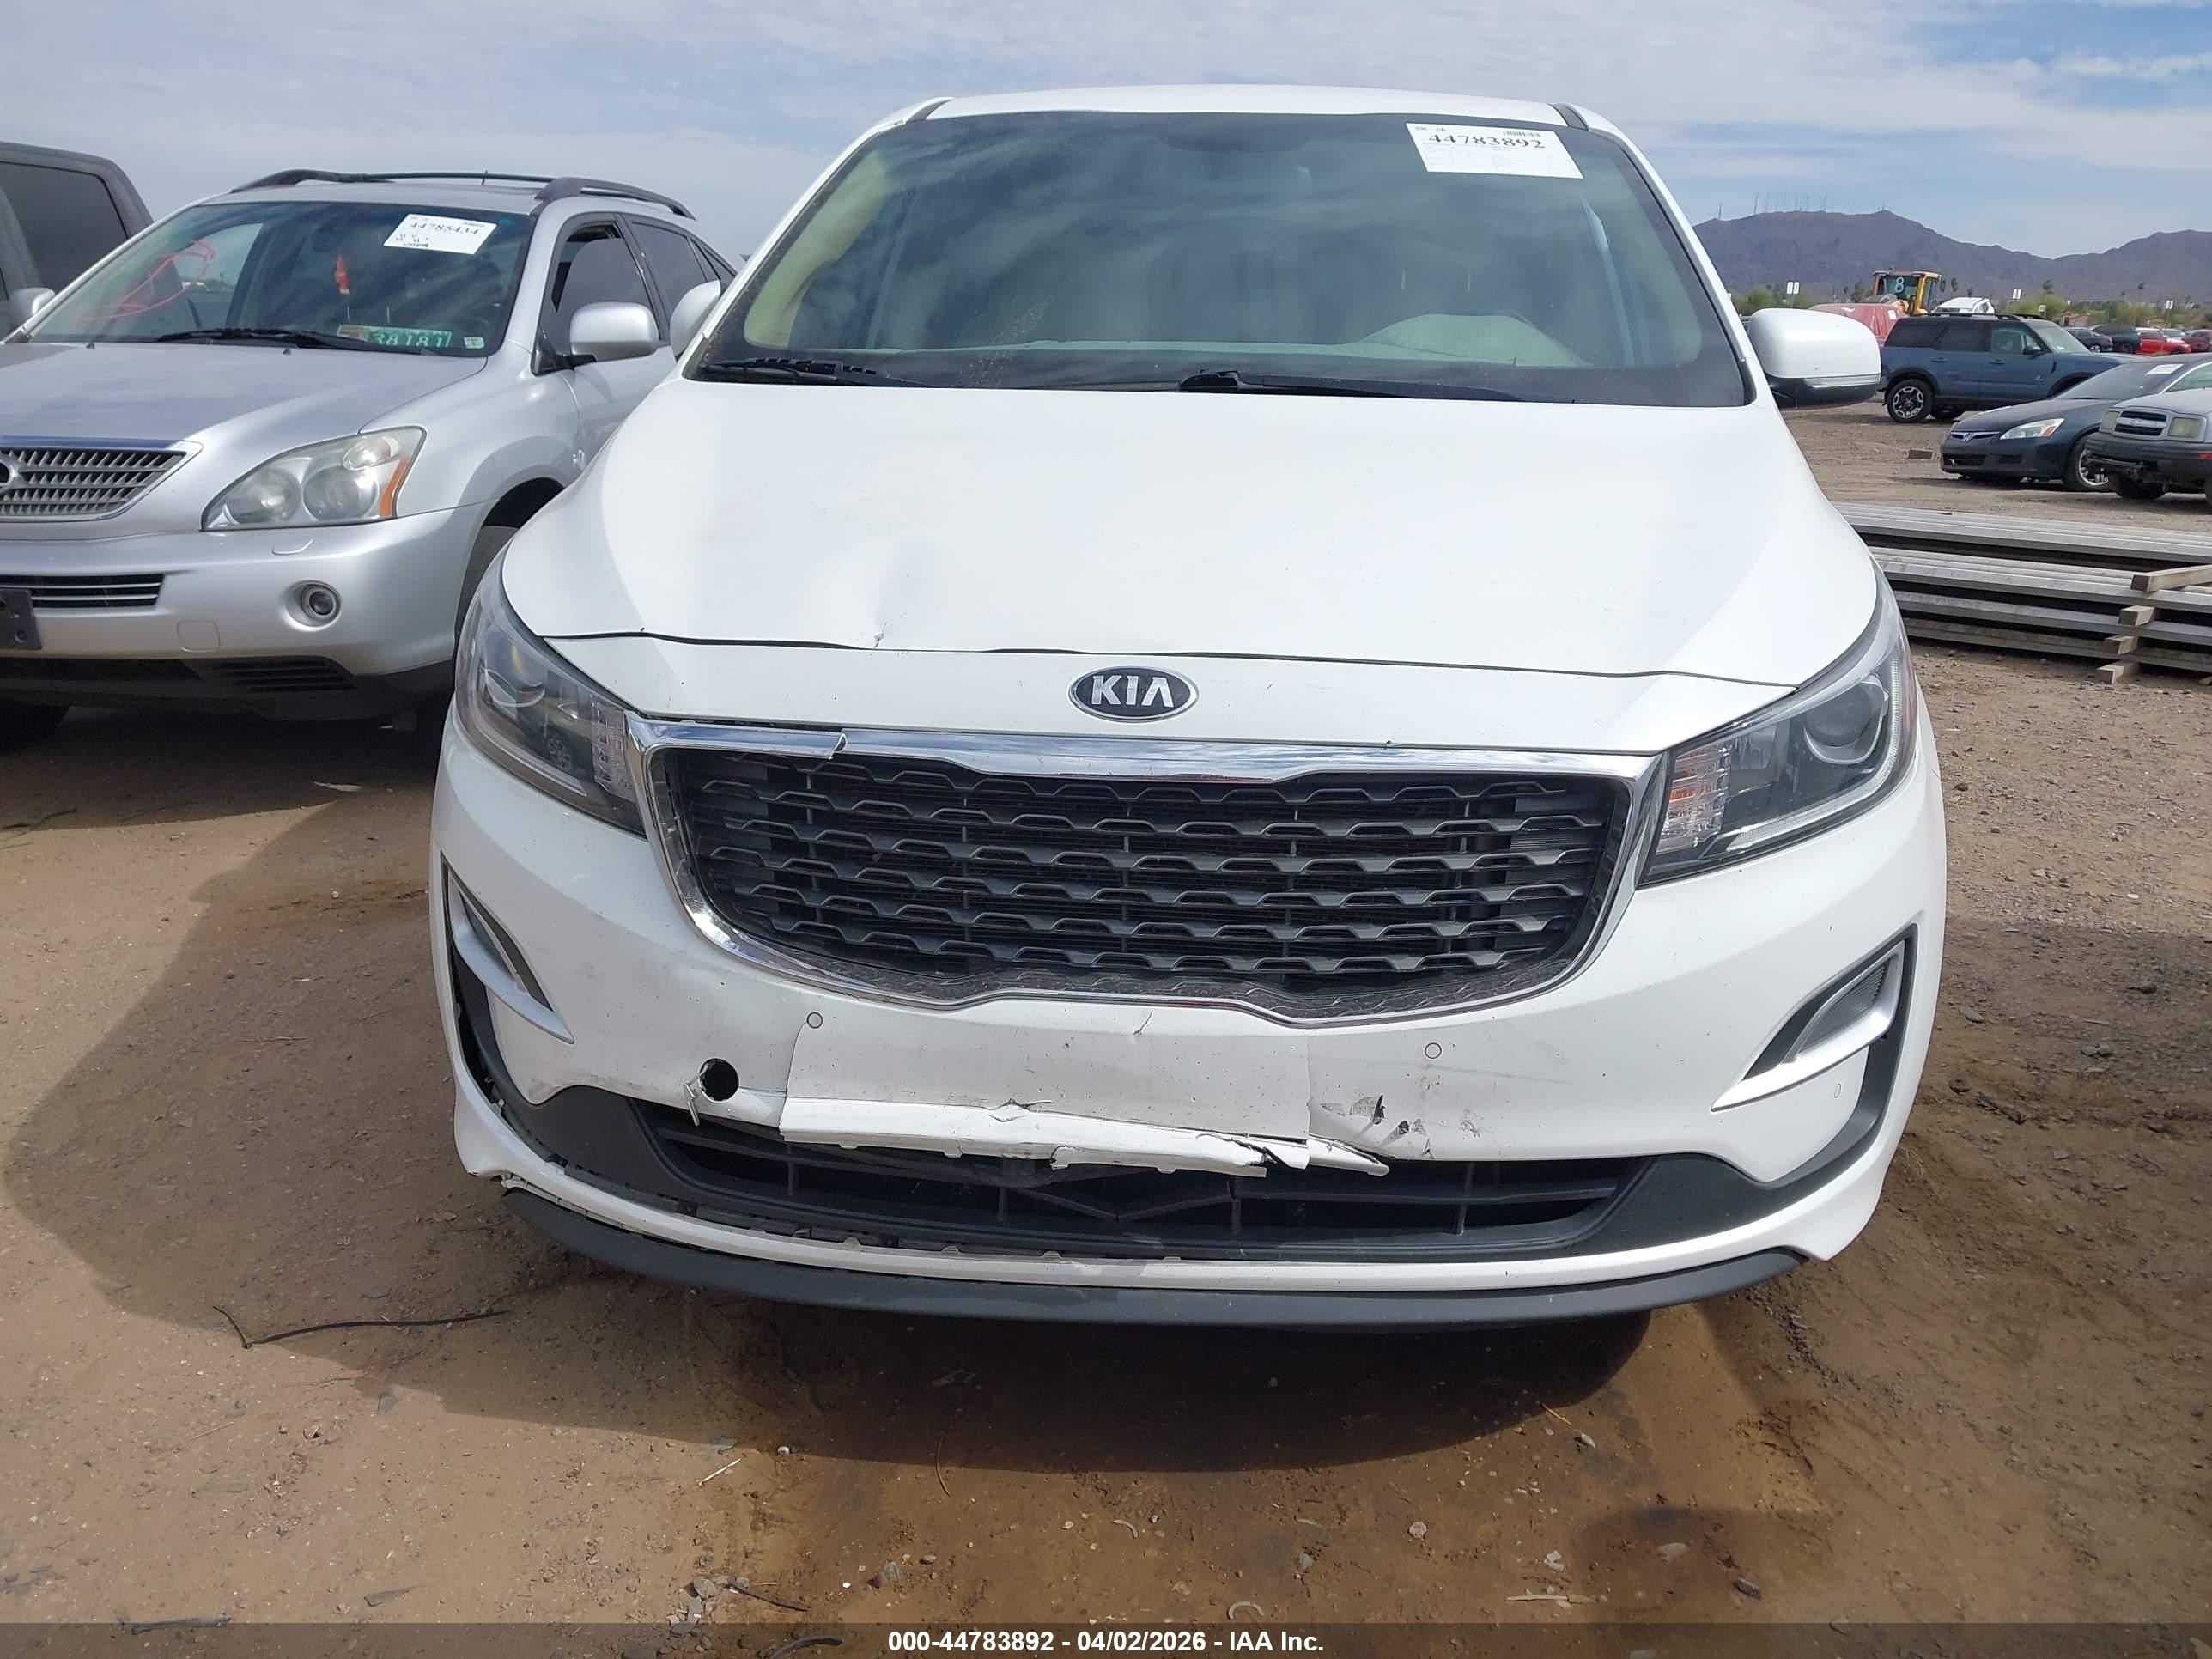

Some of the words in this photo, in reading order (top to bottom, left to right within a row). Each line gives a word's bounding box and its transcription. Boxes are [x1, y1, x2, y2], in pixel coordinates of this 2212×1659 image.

[1428, 134, 1546, 149] 44783892
[1895, 276, 1905, 293] 8
[1091, 675, 1175, 708] KIA
